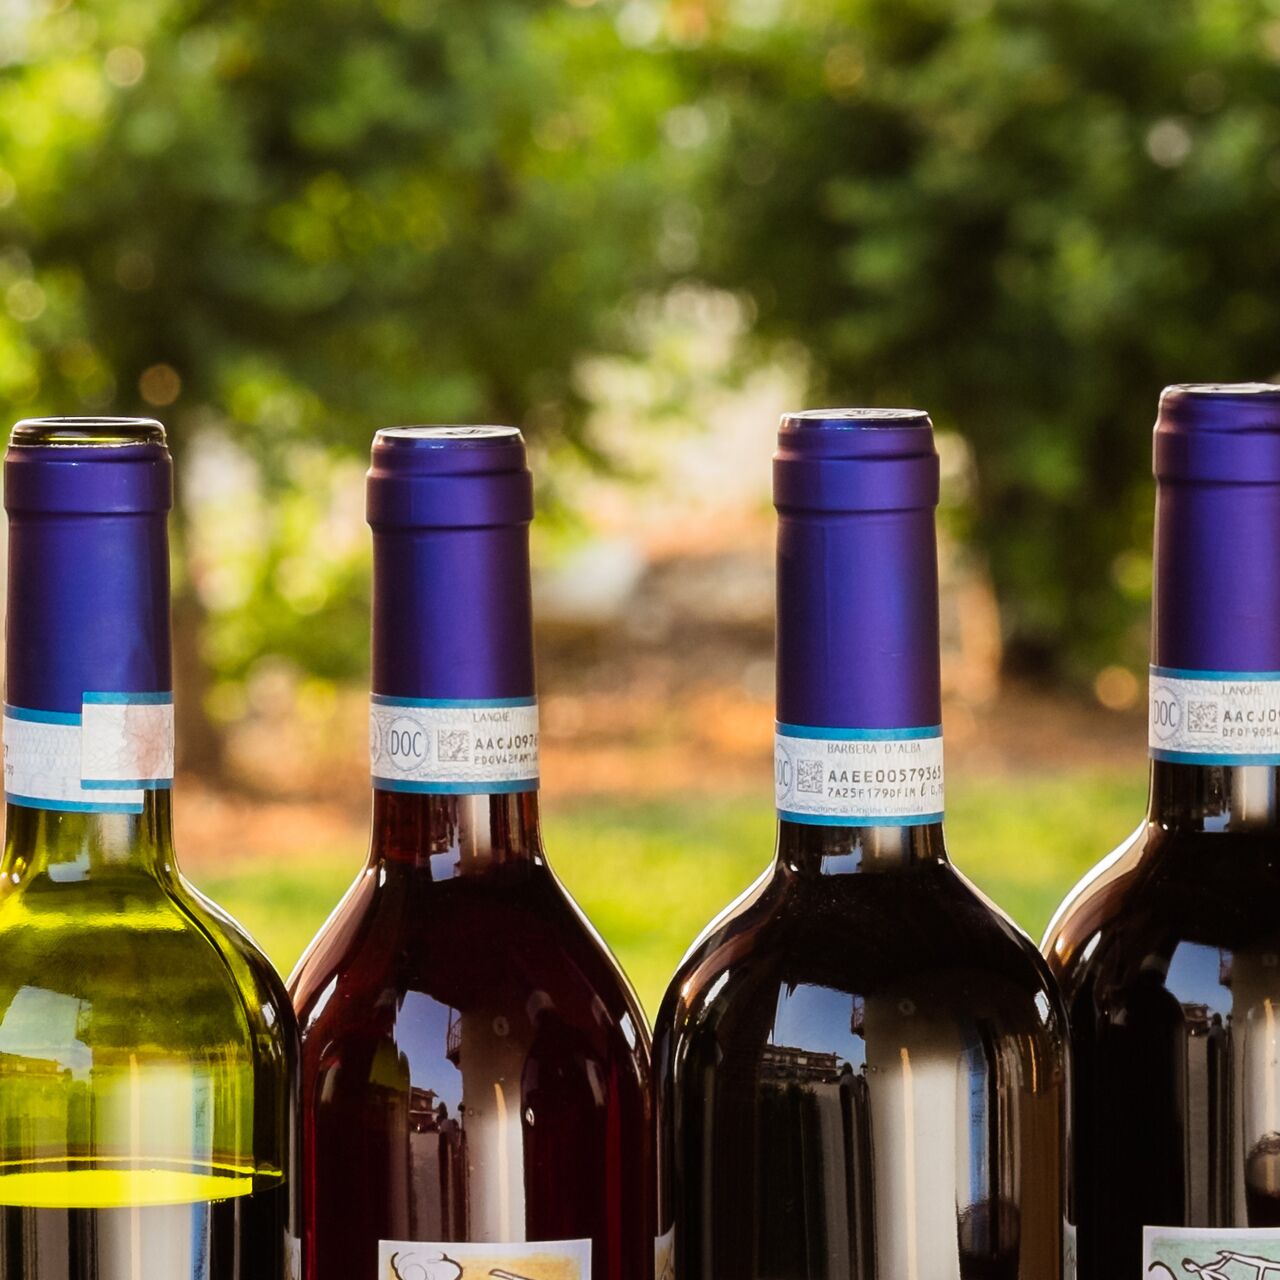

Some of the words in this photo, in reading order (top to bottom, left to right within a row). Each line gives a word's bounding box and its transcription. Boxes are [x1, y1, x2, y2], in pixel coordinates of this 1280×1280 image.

[1154, 700, 1176, 727] DOC
[391, 730, 422, 757] DOC
[827, 743, 877, 754] BARBERA
[884, 743, 921, 754] D'ALBA
